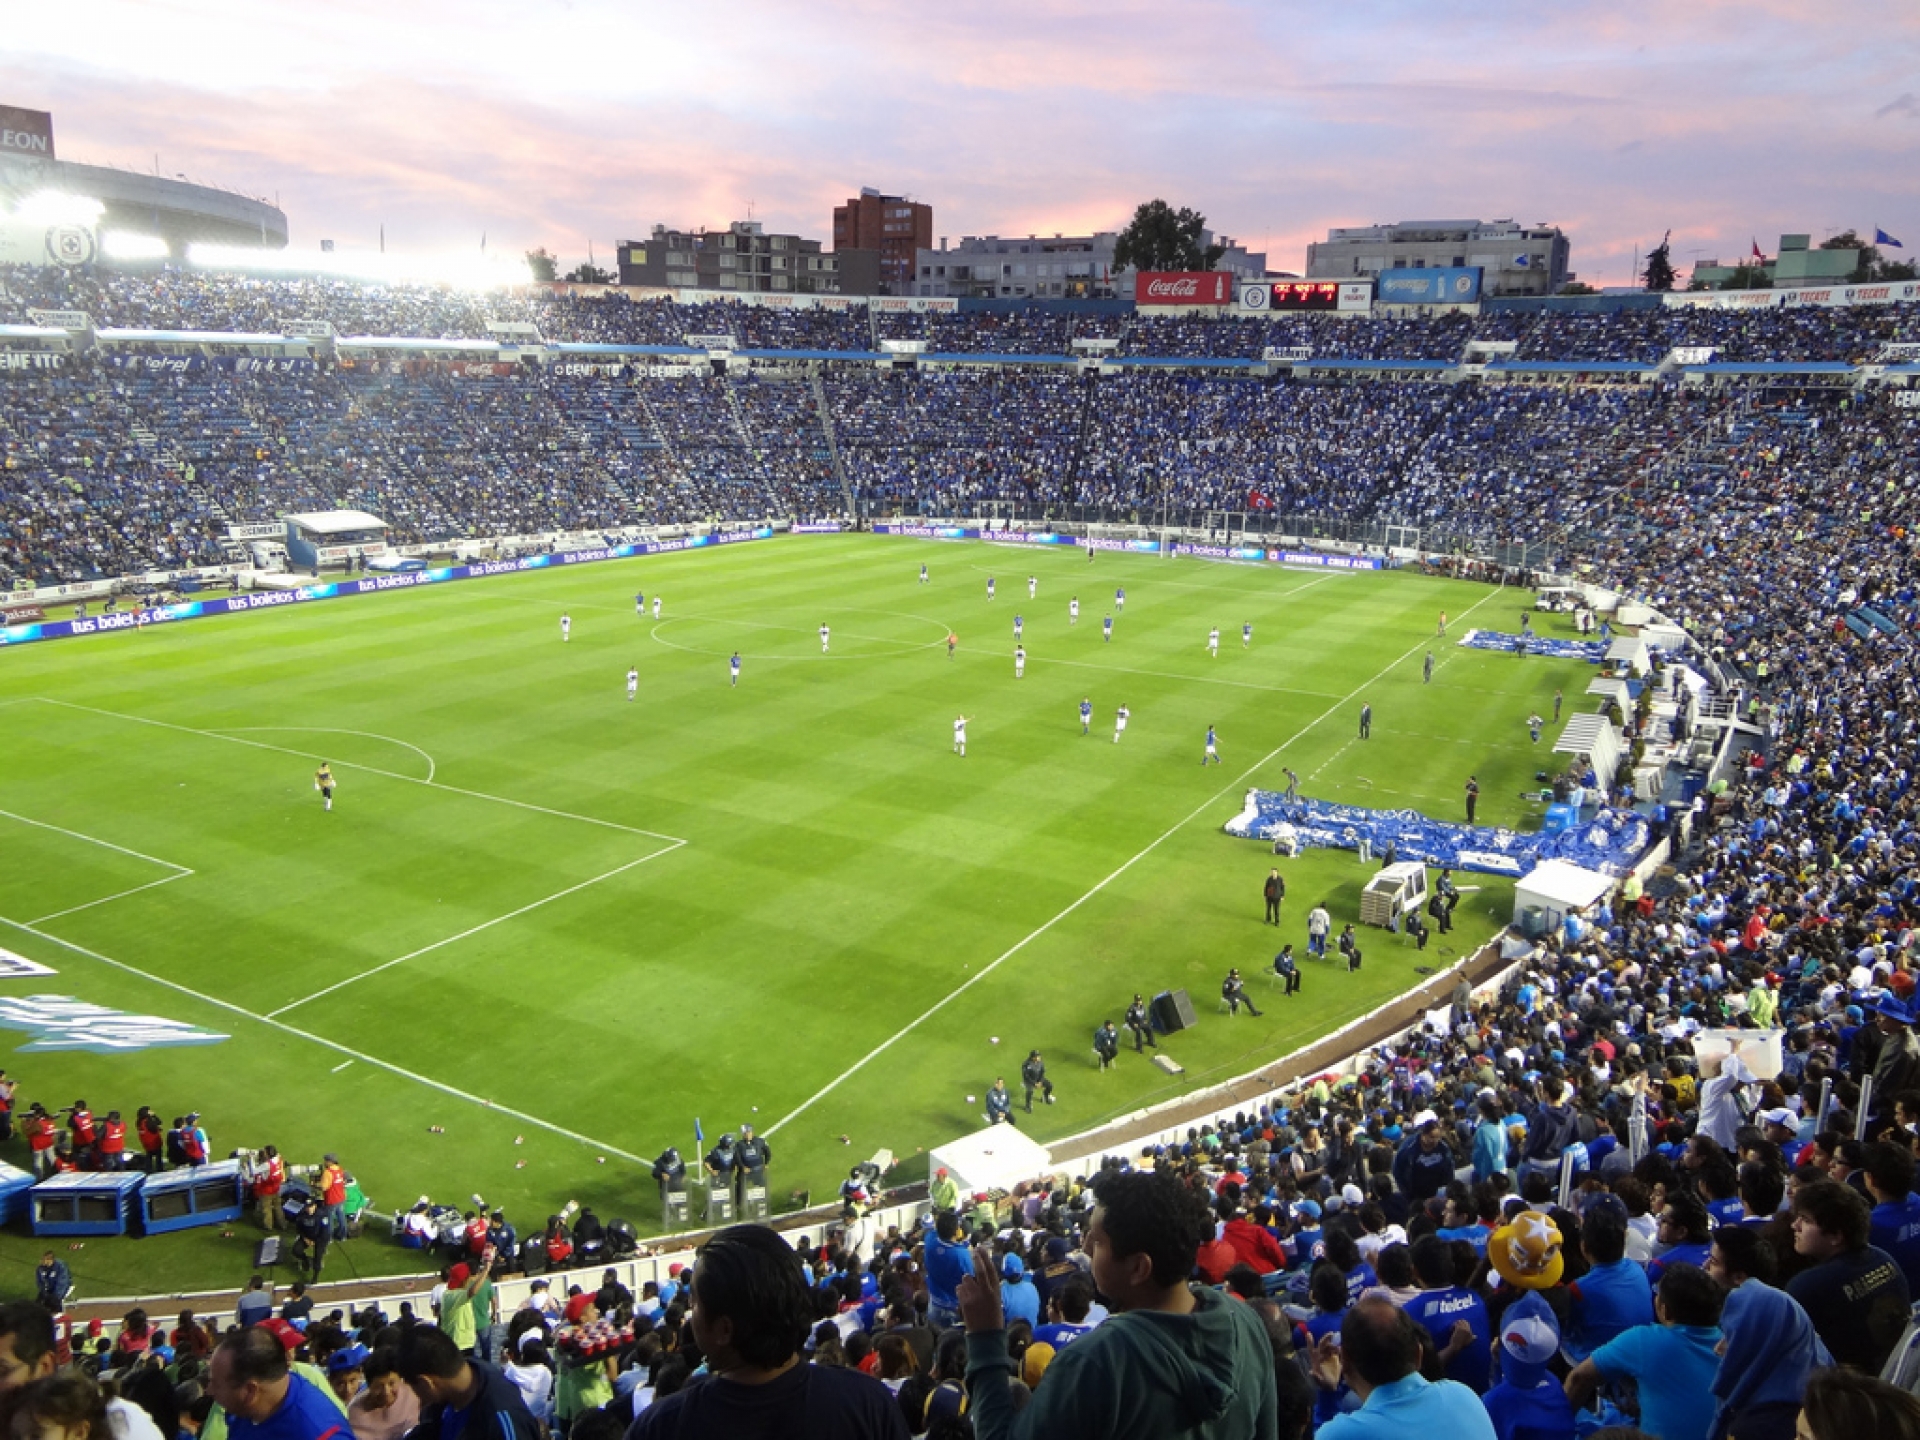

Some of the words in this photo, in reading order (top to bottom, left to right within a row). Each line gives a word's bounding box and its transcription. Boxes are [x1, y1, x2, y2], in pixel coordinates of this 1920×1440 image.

[3, 129, 47, 151] EON
[1147, 279, 1200, 296] Coca-Cola
[485, 561, 516, 574] boletos
[358, 580, 375, 591] tus
[376, 574, 414, 588] boletos
[227, 599, 248, 610] tus
[248, 591, 293, 607] boletos
[71, 620, 96, 633] tus
[1440, 1294, 1473, 1313] telcel
